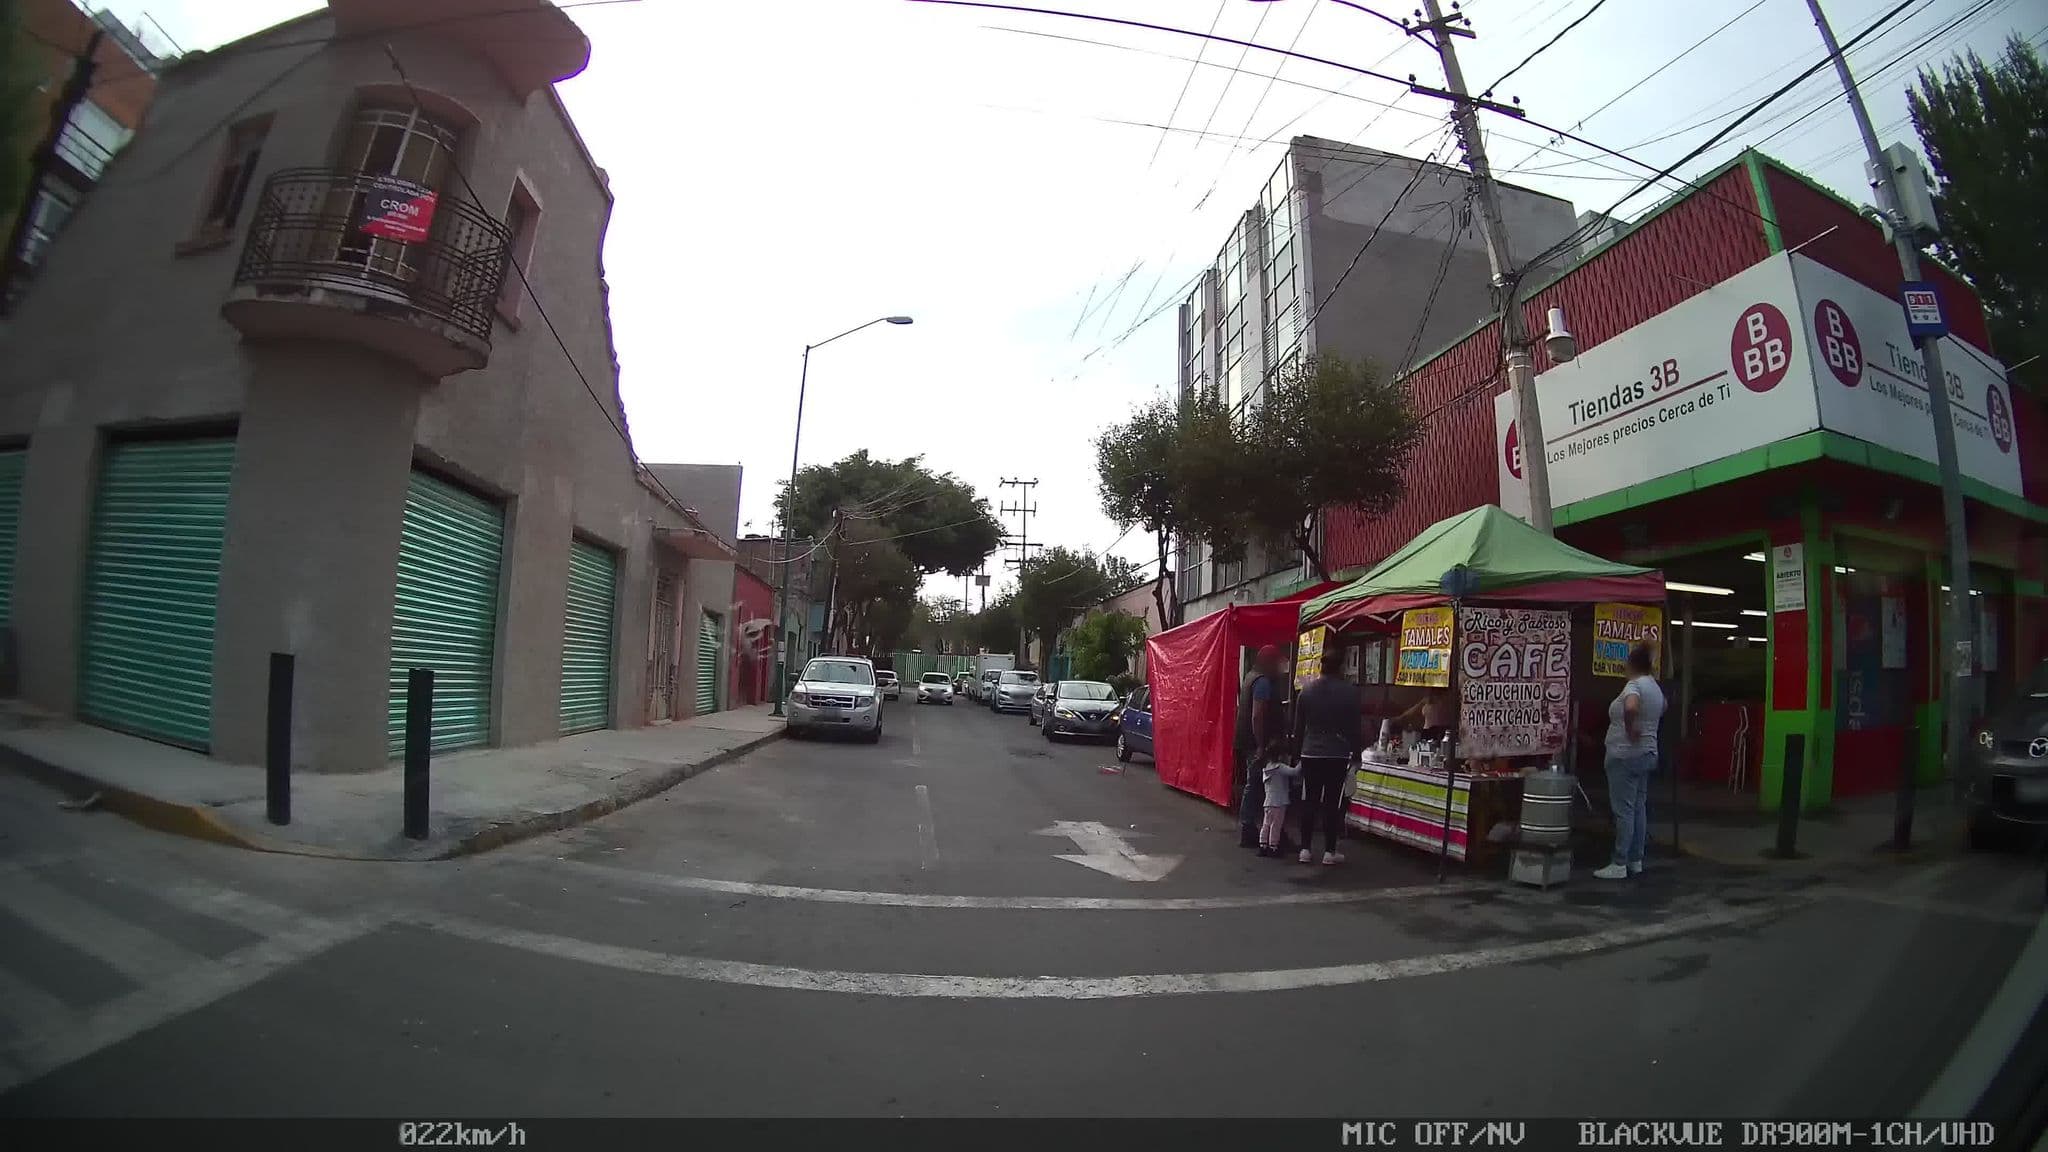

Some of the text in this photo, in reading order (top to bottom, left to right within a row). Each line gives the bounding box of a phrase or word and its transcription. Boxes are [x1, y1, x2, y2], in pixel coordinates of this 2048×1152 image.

[380, 199, 419, 216] CROM
[1747, 312, 1767, 345] B
[1826, 306, 1843, 338] B
[1744, 338, 1786, 381] BB
[1826, 335, 1859, 374] BB
[1568, 358, 1680, 426] Tiendas 3B
[1869, 375, 1888, 395] Los
[1890, 382, 1924, 411] Mejores
[1946, 371, 1964, 400] 3B
[1547, 383, 1731, 464] Los Mejores precios Cerca de Ti
[1405, 626, 1450, 646] TAMALES
[1464, 611, 1501, 631] Rico
[1518, 614, 1567, 634] Sabroso
[1597, 620, 1658, 640] TAMALES
[1463, 633, 1569, 679] CAFÉ
[1469, 684, 1541, 700] CAPUCHINO
[1468, 709, 1541, 726] AMERICANO
